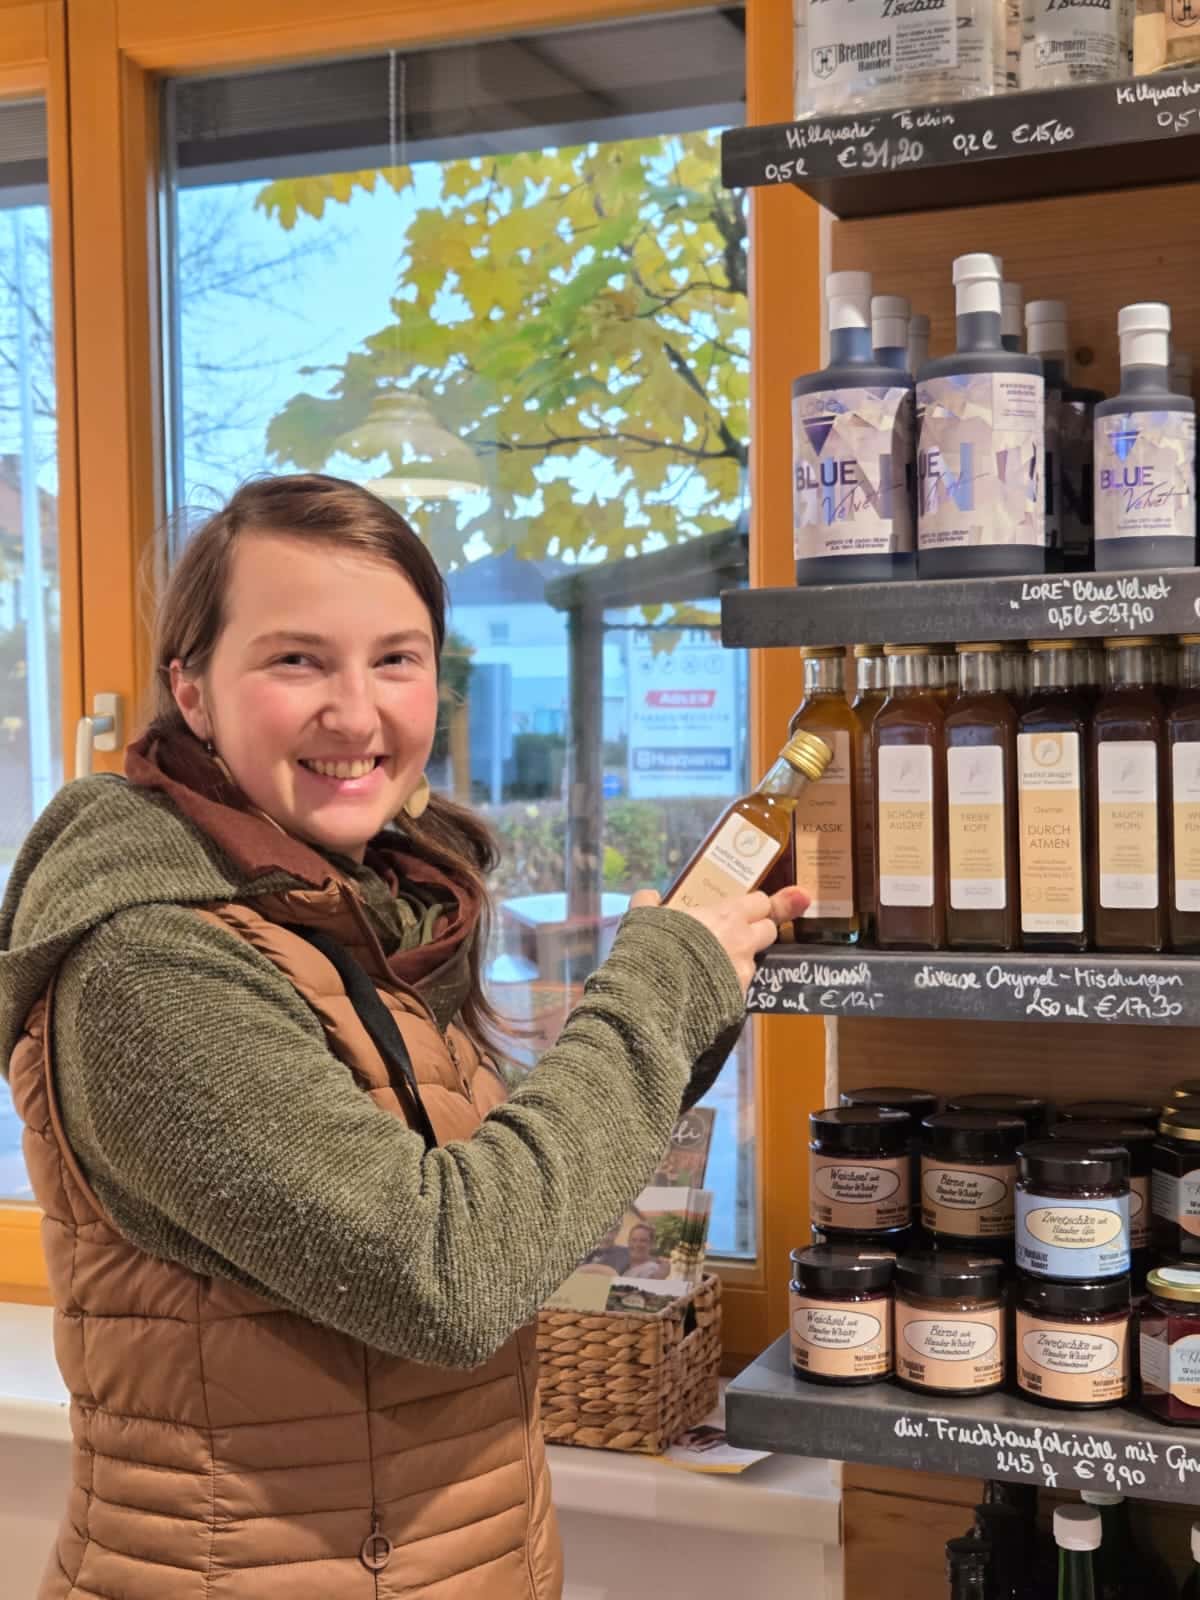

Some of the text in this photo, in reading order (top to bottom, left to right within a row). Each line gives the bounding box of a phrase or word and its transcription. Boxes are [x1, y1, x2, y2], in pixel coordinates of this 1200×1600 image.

[838, 37, 892, 64] Brennerei
[796, 460, 858, 491] BLUE
[1100, 466, 1154, 490] BLUE
[1072, 579, 1118, 601] Blue
[1117, 576, 1171, 601] Velvet
[802, 823, 844, 833] KLASSIK
[1027, 824, 1071, 836] DURCH
[1028, 838, 1070, 849] ATMEN
[1026, 989, 1062, 1017] 250
[1065, 995, 1088, 1018] ml
[929, 1324, 958, 1337] Birne
[894, 1417, 928, 1438] div.
[1125, 1441, 1158, 1464] mit
[997, 1451, 1034, 1473] 245
[1042, 1464, 1059, 1488] g
